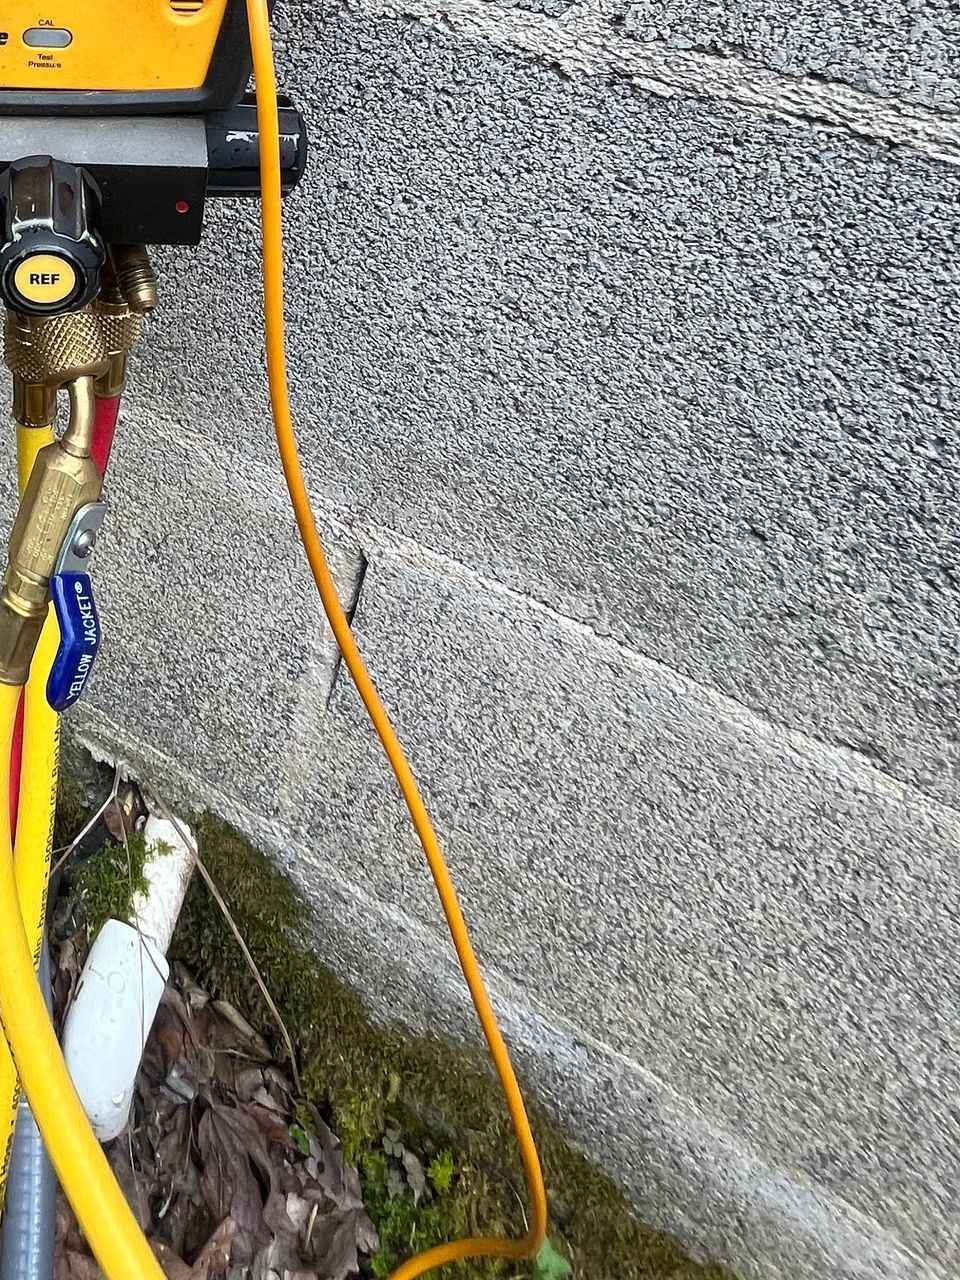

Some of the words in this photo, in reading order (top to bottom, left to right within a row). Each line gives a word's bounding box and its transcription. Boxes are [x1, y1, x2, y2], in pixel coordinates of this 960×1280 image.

[38, 19, 55, 27] CAL
[37, 53, 54, 61] Test
[29, 271, 61, 287] REF
[66, 654, 94, 700] YELLOW
